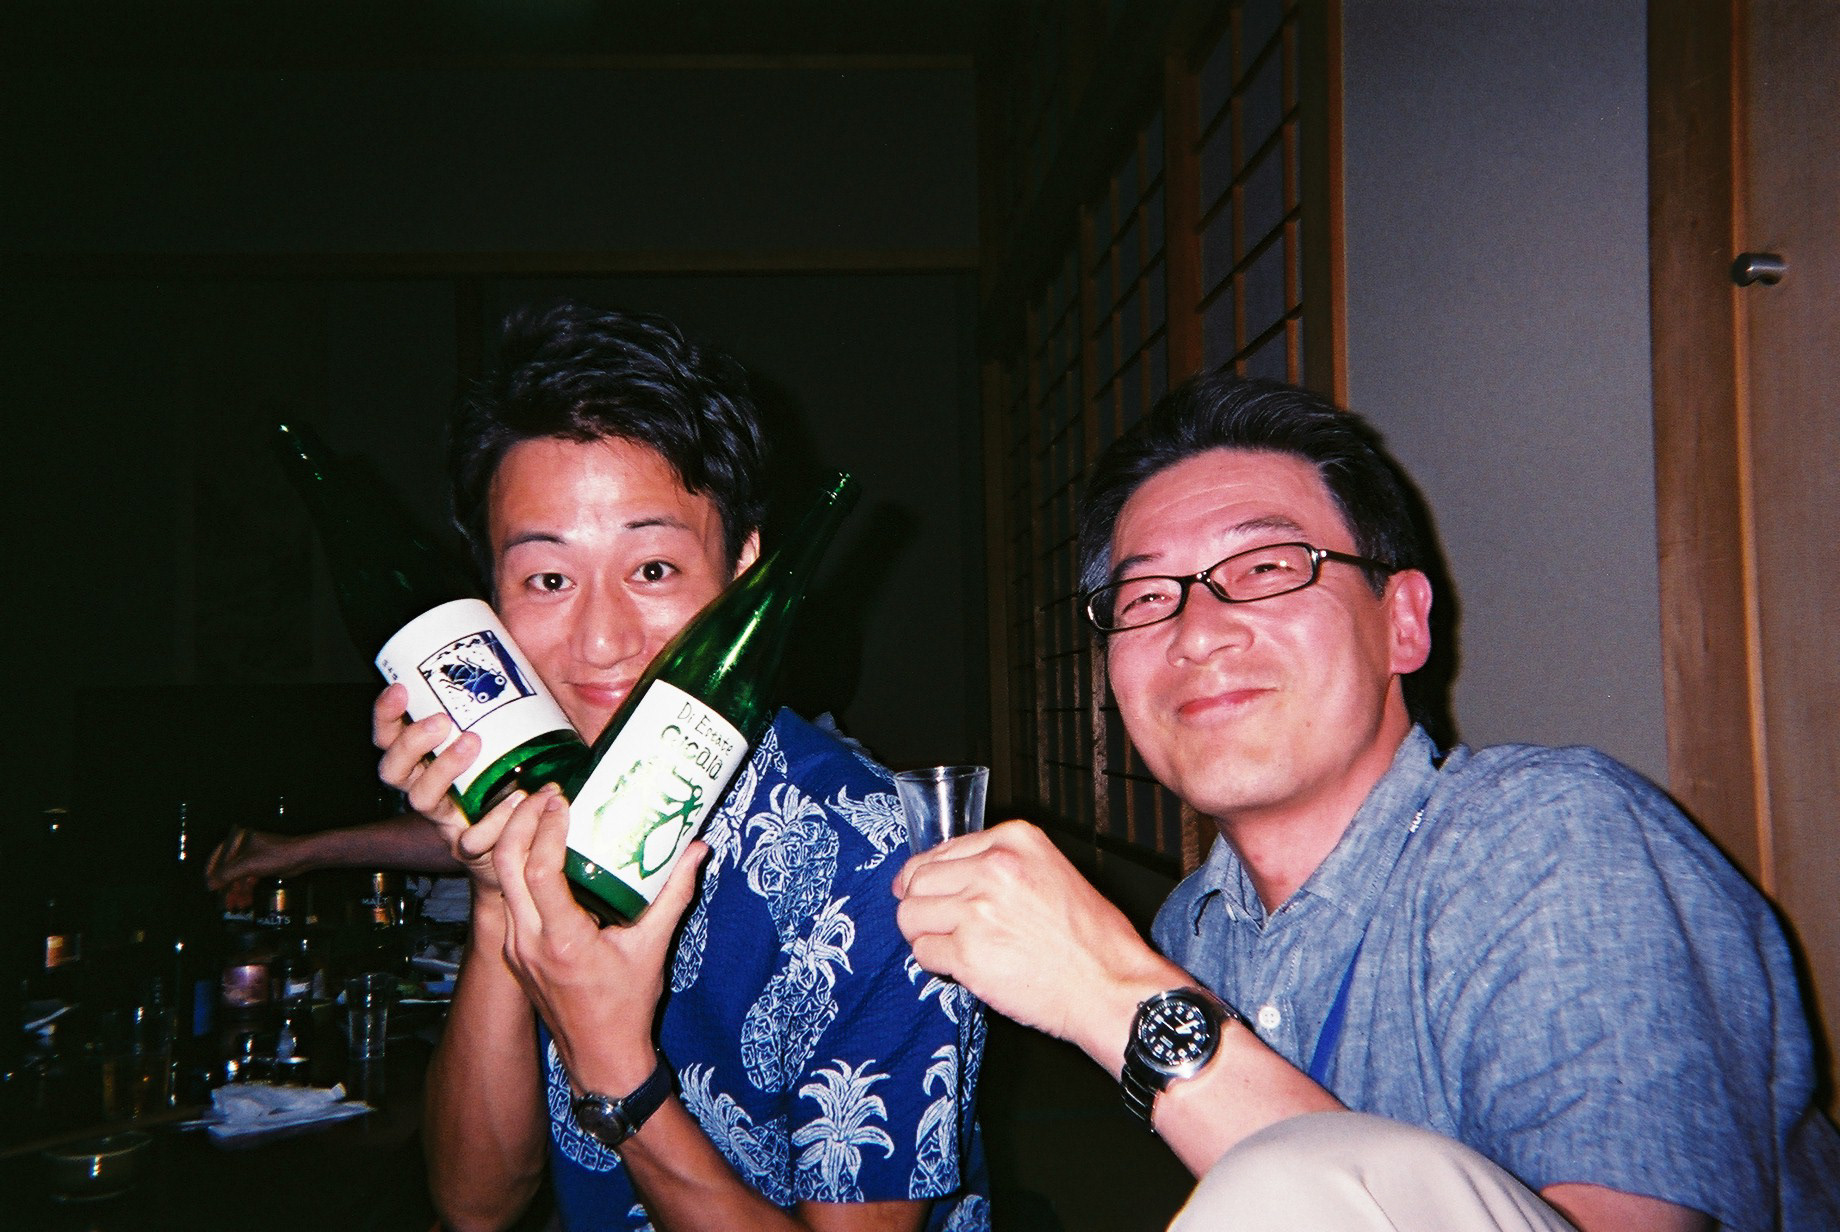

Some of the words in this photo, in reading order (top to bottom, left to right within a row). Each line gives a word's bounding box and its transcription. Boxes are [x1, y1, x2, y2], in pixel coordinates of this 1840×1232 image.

[660, 723, 723, 781] Cicala
[677, 701, 695, 723] Di
[694, 714, 735, 757] Estate
